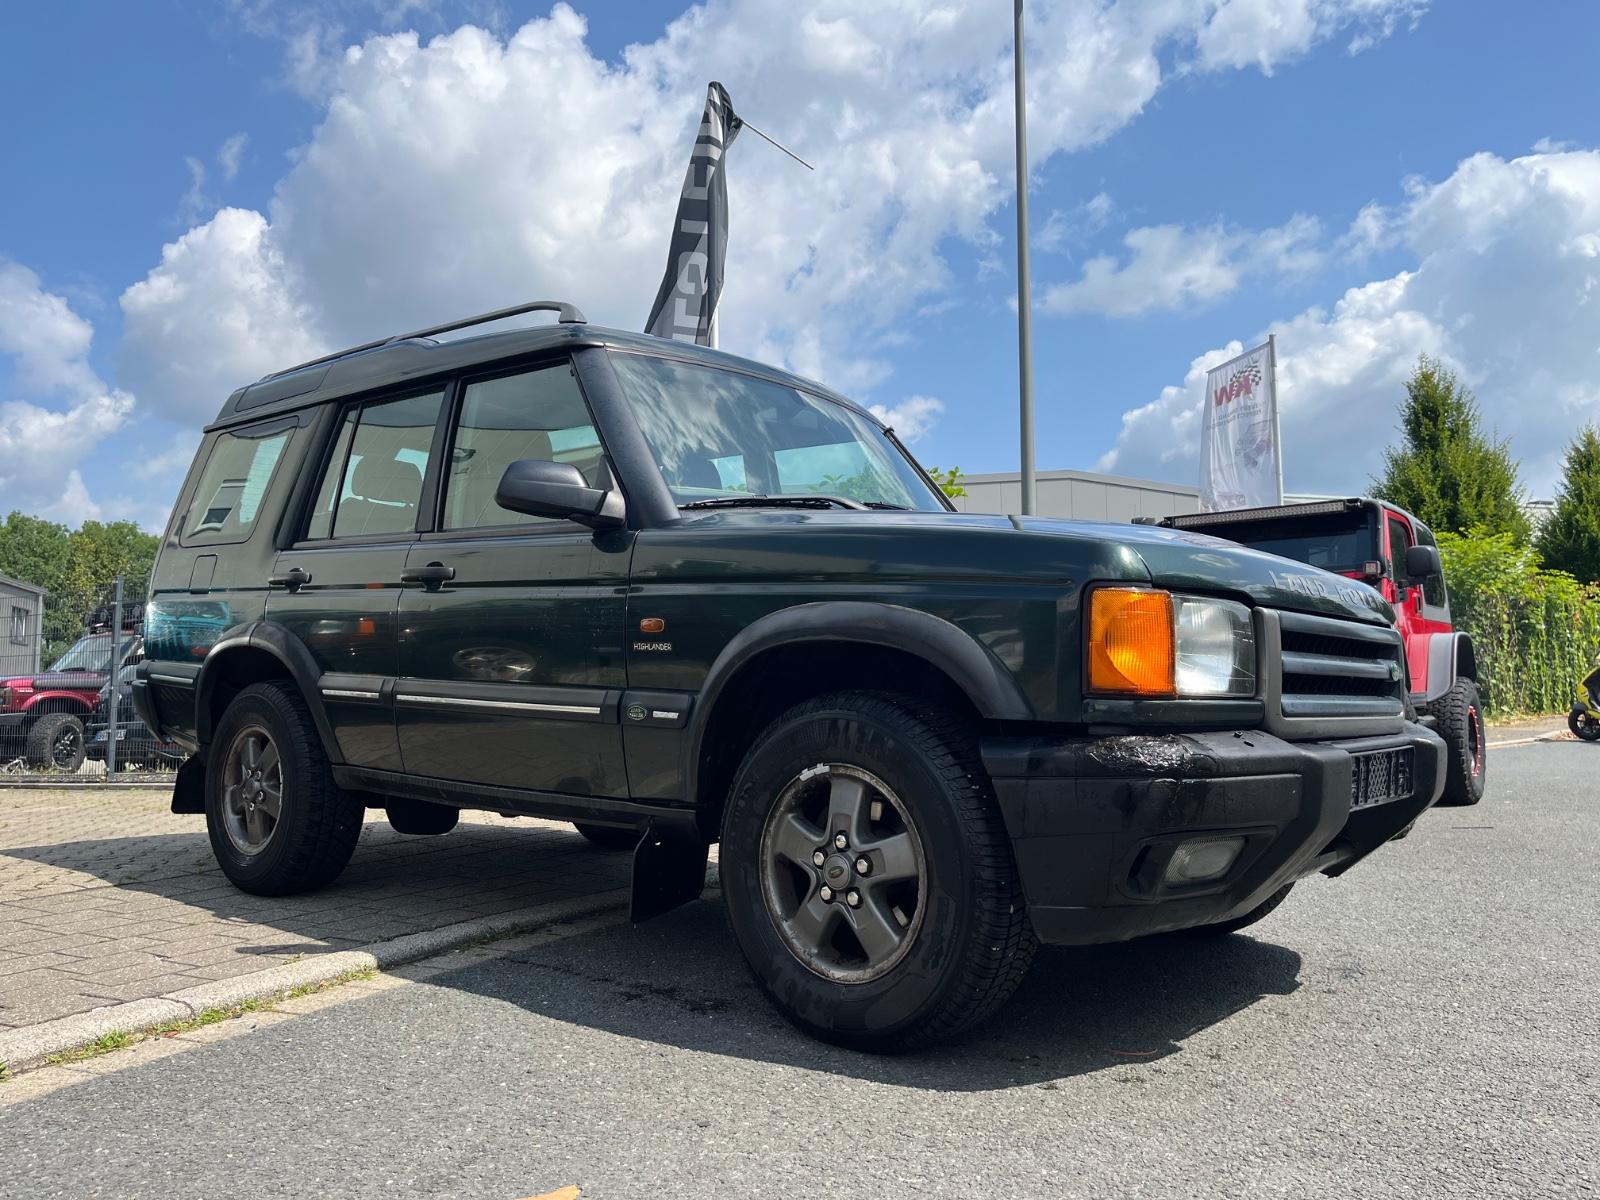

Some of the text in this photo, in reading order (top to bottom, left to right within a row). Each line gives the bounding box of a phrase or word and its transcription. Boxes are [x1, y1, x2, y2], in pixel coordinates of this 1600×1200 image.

[1268, 570, 1384, 610] LAND ROVER
[633, 642, 672, 650] HIGHLANDER
